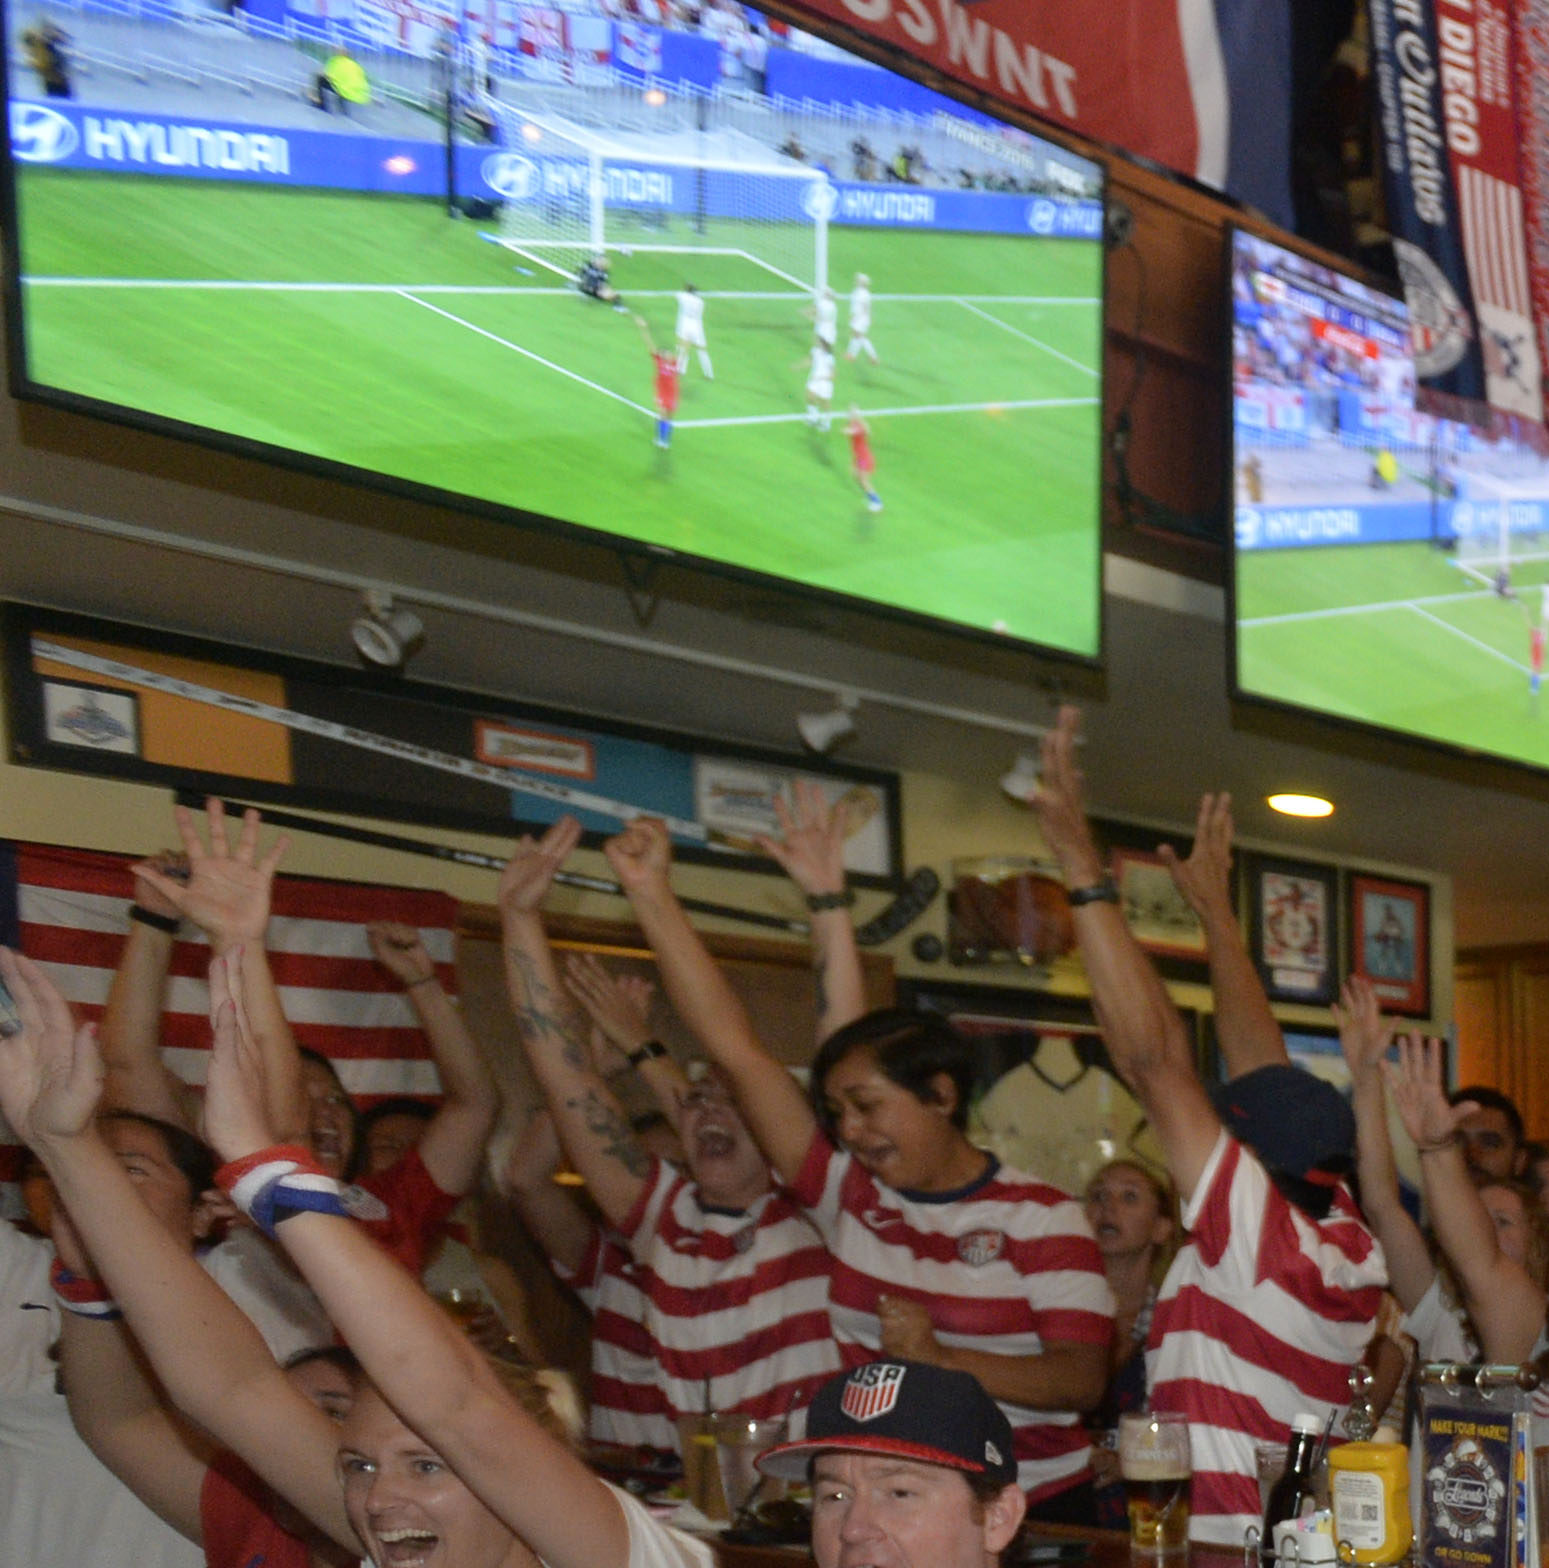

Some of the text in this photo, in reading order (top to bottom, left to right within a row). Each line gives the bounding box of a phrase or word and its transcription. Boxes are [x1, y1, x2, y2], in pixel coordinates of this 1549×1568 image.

[83, 115, 290, 176] HYUNDAI
[1394, 30, 1449, 226] Outlaws
[1440, 17, 1481, 156] DIEGO
